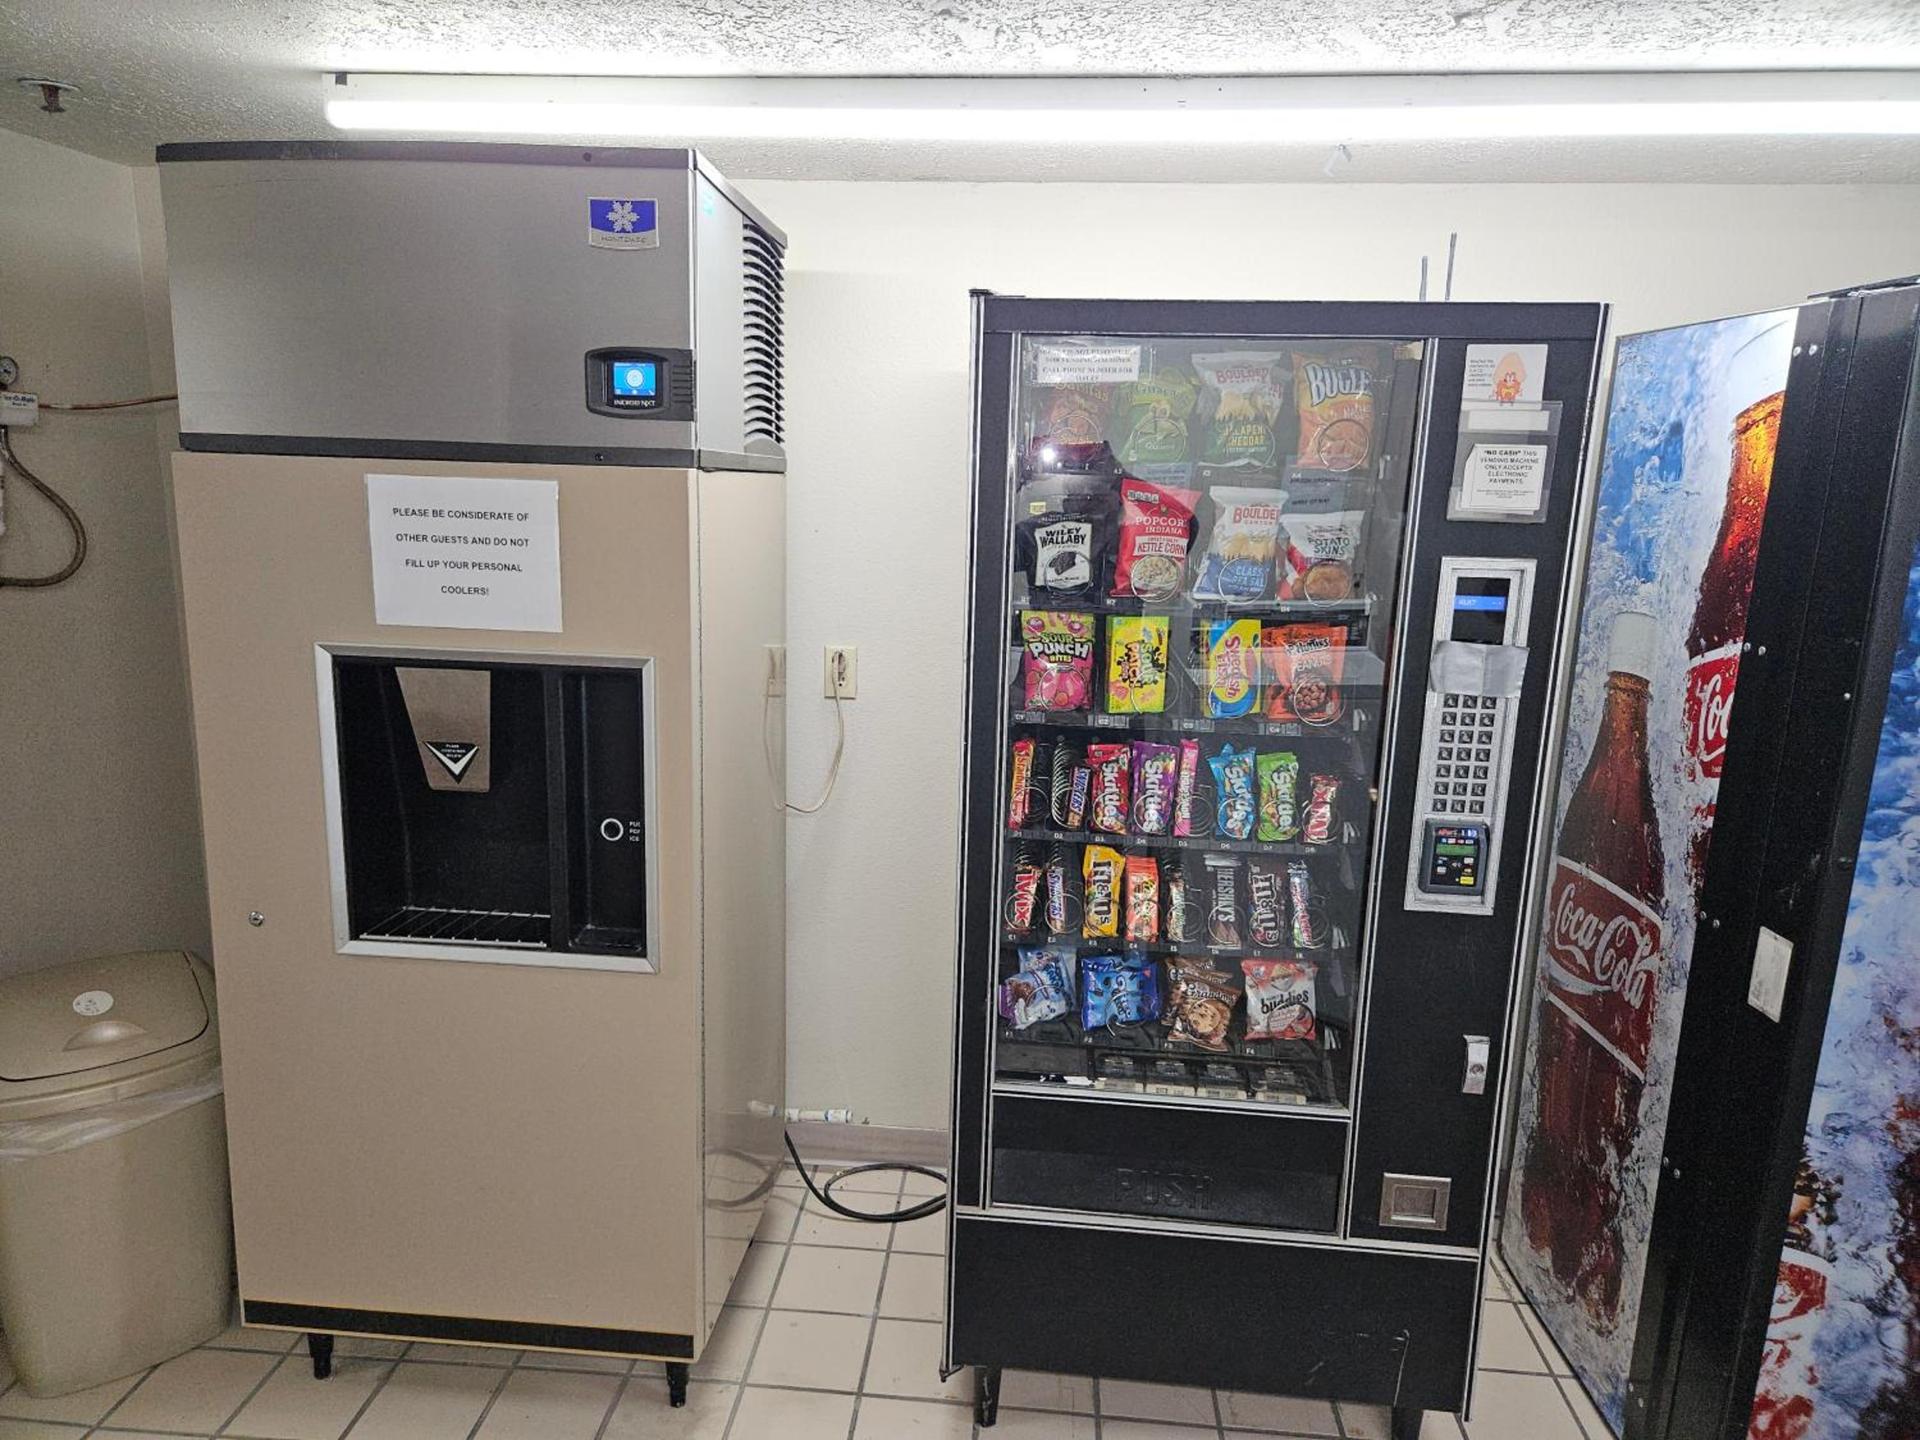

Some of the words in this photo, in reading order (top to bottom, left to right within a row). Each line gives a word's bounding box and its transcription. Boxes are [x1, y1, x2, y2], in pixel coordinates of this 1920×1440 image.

[1304, 363, 1373, 406] BUGLE
[393, 508, 430, 517] PLEASE
[447, 511, 514, 521] CONSIDERATE
[517, 513, 529, 521] OF
[1136, 516, 1188, 527] POPCOR
[1046, 527, 1082, 537] WILEY
[1145, 527, 1183, 535] INDIANA
[396, 533, 428, 542] OTHER
[431, 536, 469, 545] GUESTS
[471, 537, 491, 545] AND
[494, 537, 508, 546] DO
[510, 538, 529, 547] NOT
[1040, 534, 1086, 548] WALLABY
[1307, 537, 1350, 547] POTATO
[1137, 543, 1163, 553] KETTLE
[1165, 543, 1185, 554] CORN
[1314, 545, 1345, 556] SKINS
[405, 559, 425, 567] FILL
[427, 560, 440, 568] UP
[443, 561, 469, 570] YOUR
[472, 562, 523, 572] PERSONAL
[441, 586, 489, 595] COOLERS!
[1041, 633, 1075, 644] SOUR
[1029, 641, 1089, 659] PUNCH
[1050, 655, 1072, 663] BITES
[1225, 635, 1241, 698] Swedish
[1071, 768, 1089, 812] SNICKERS
[1102, 763, 1121, 826] Skittles
[1144, 760, 1164, 833] Skittles
[1224, 766, 1251, 829] Skittles
[1555, 883, 1659, 1010] Coca-Cola
[1261, 989, 1309, 1014] buddies
